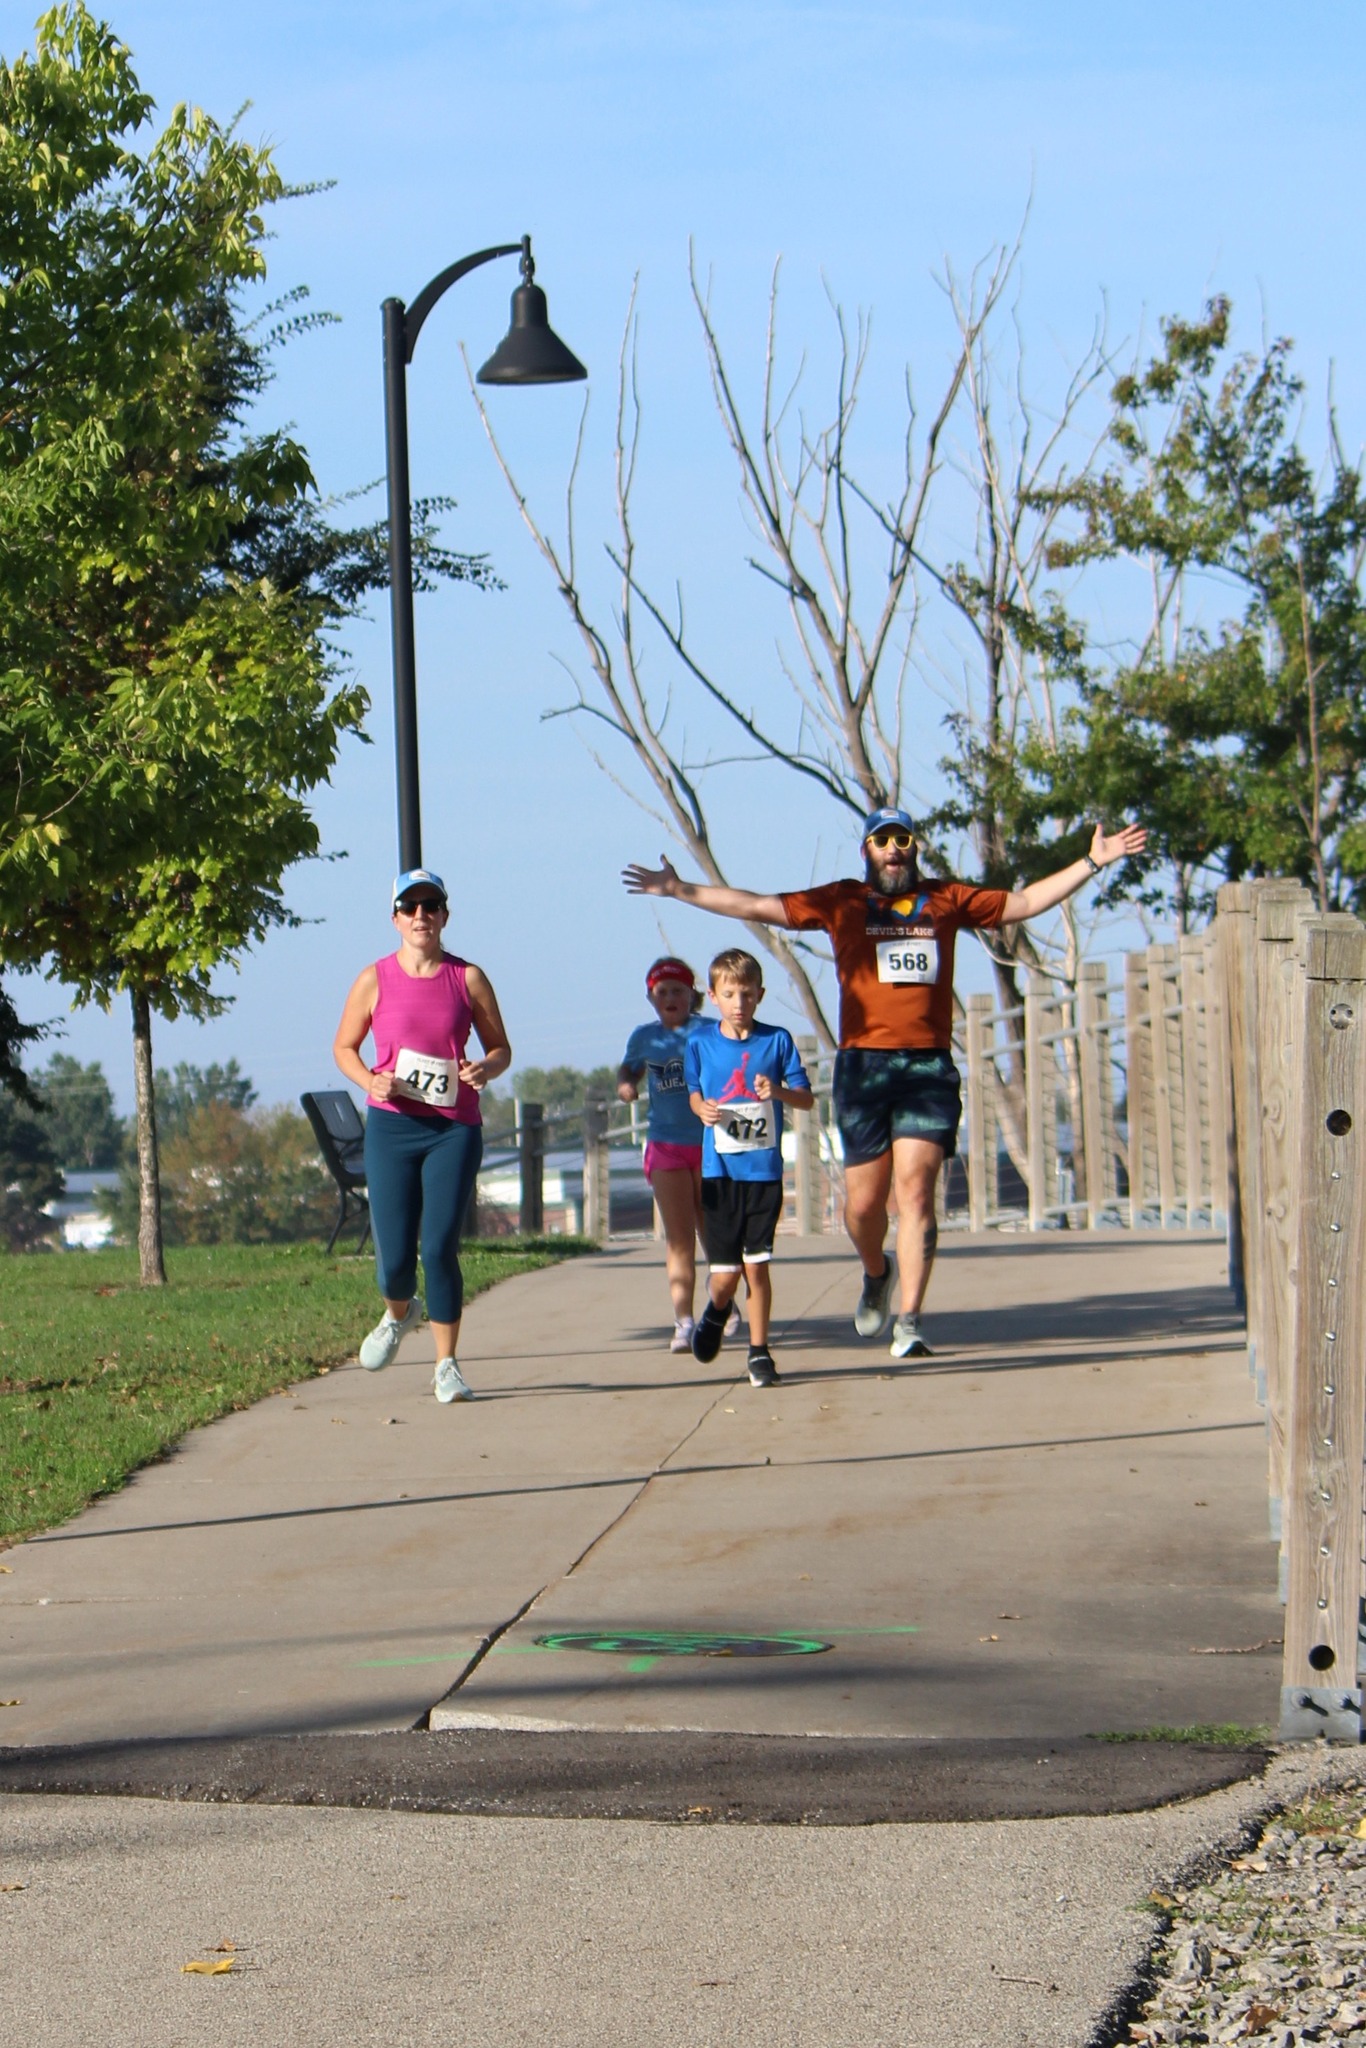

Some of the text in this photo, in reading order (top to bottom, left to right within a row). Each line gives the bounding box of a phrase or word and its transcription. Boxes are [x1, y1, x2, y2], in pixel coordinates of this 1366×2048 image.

[865, 926, 934, 936] DEVIL'S LAKE
[888, 952, 929, 972] 568
[405, 1069, 449, 1095] 473
[726, 1117, 768, 1140] 472
